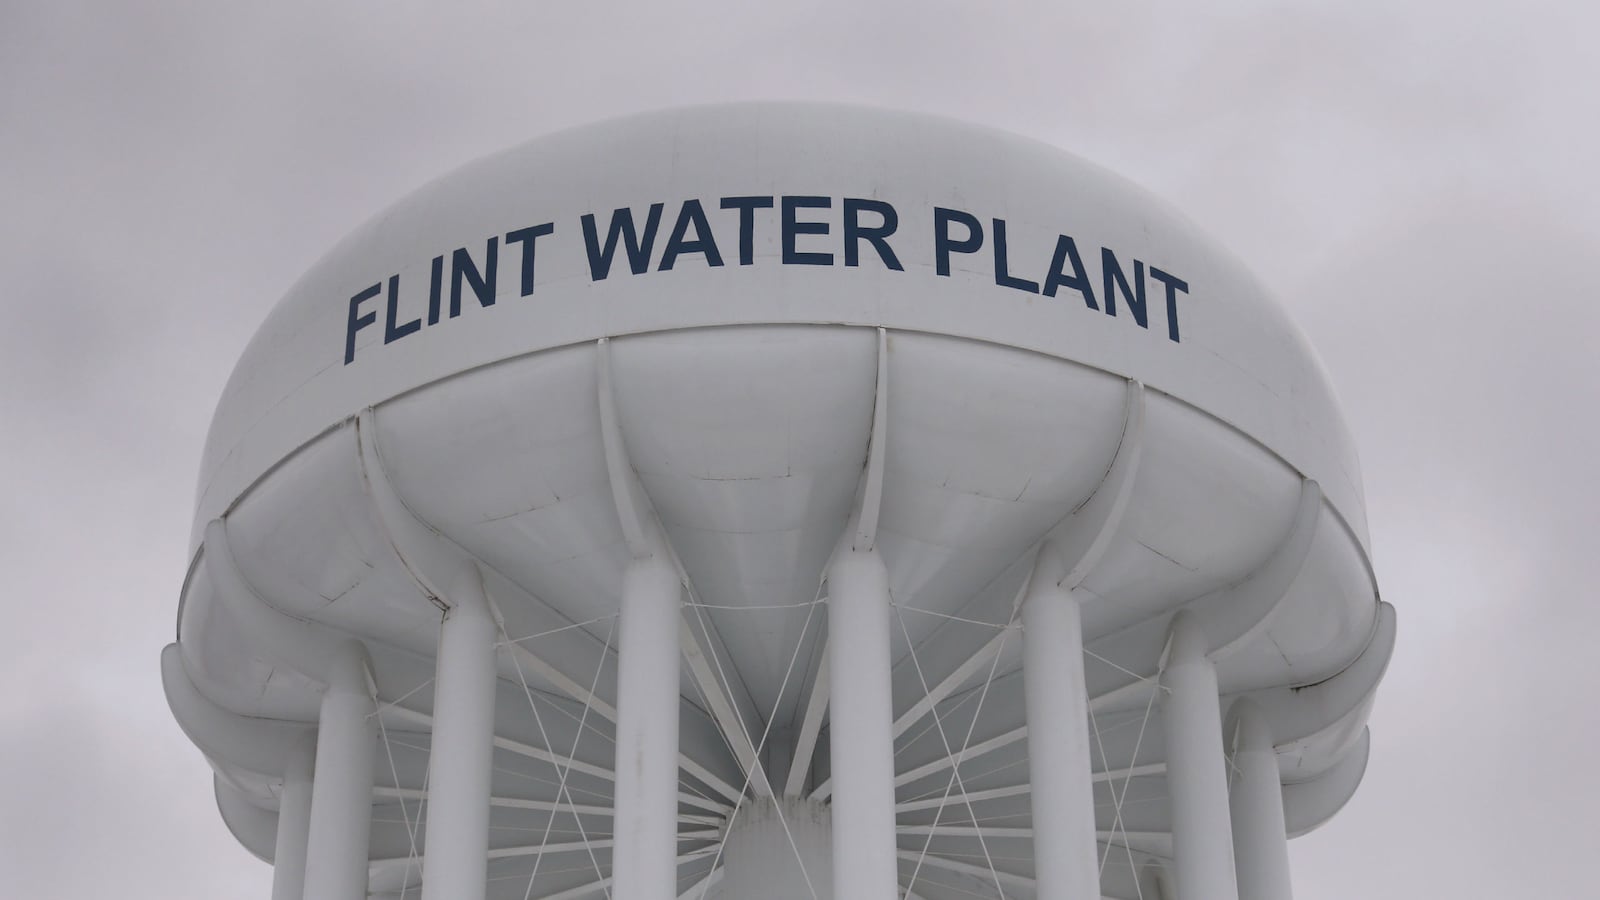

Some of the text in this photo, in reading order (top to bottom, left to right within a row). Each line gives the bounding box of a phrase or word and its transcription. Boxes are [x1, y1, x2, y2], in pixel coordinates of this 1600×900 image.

[344, 195, 1190, 365] FLINT WATER PLANT
